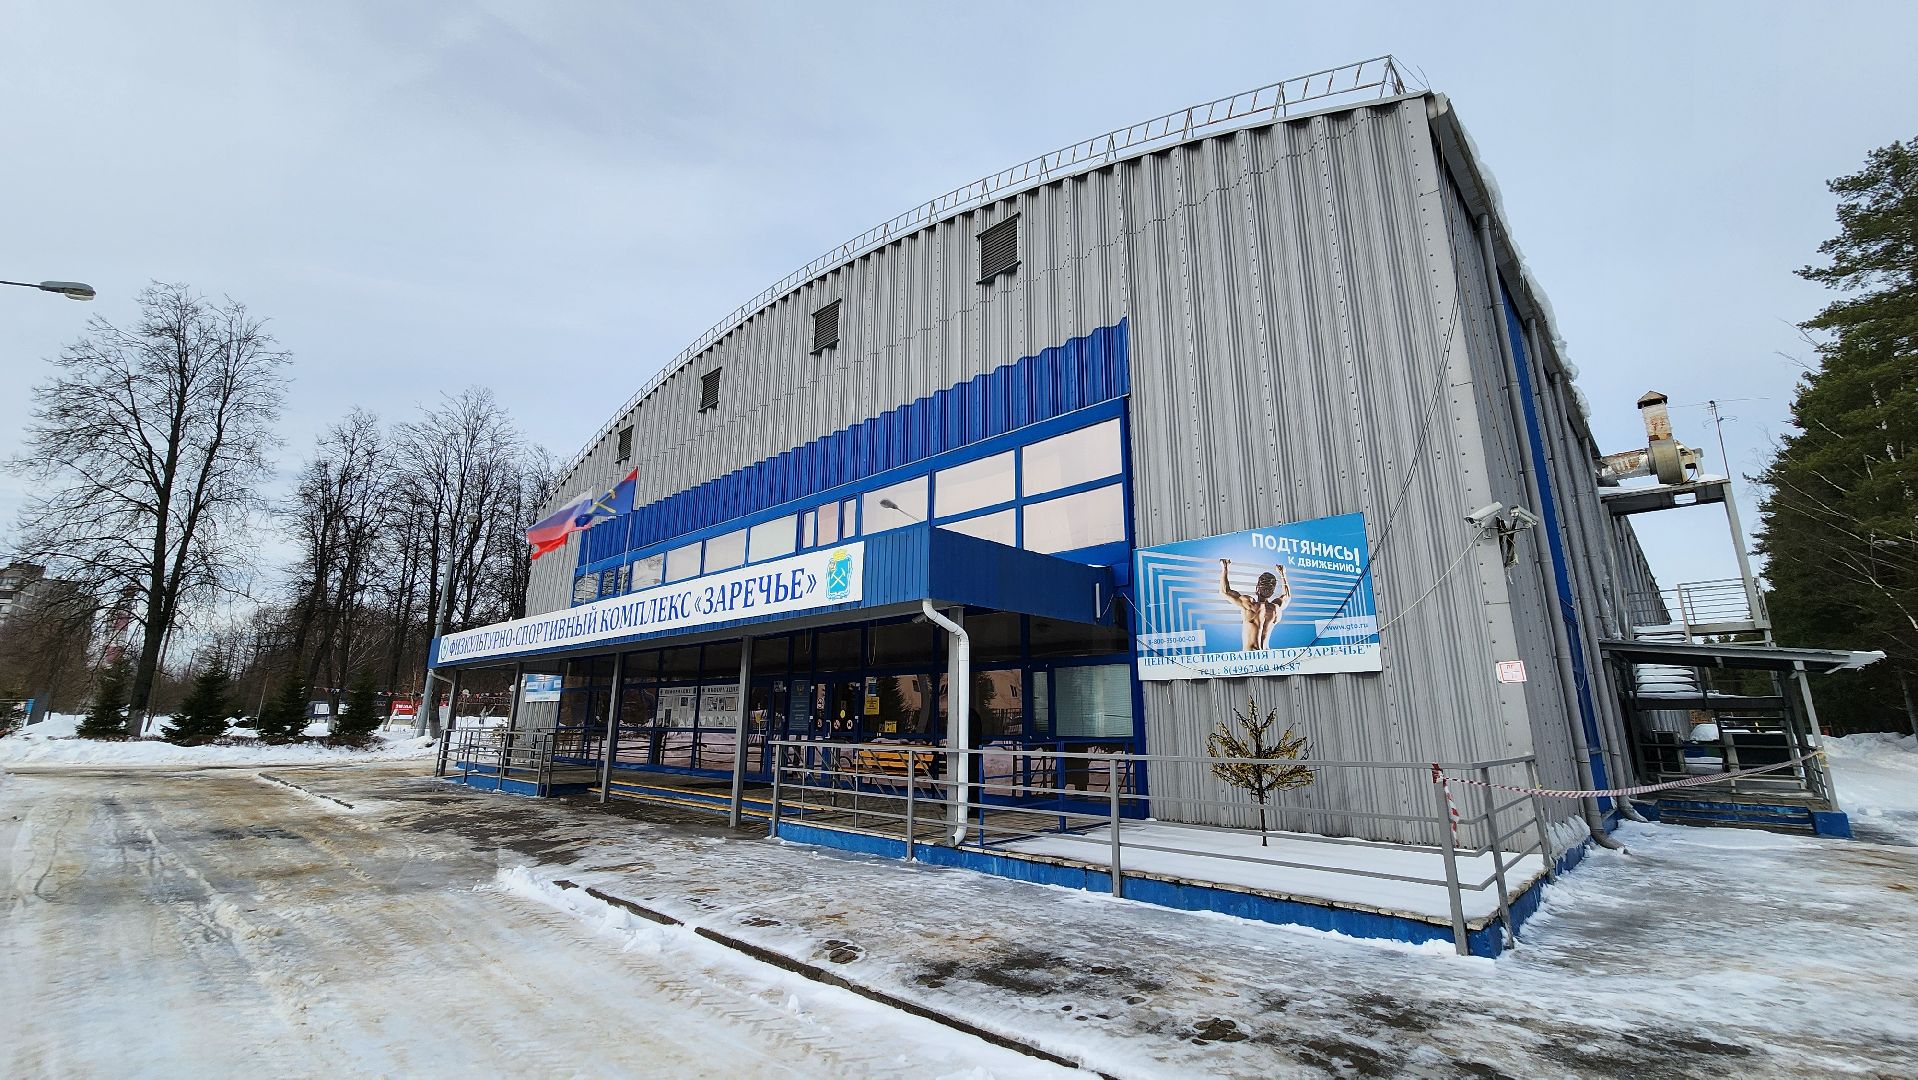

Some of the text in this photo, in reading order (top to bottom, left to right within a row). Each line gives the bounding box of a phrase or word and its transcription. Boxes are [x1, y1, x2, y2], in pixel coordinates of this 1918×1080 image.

[1287, 555, 1295, 566] К
[449, 567, 818, 657] ФИЗКУЛЬТУРНО-СПОРТИВНЫЙ КОМПЛЕКС «ЗАРЕЧЬЕ»
[1325, 622, 1369, 632] www.gto.ru
[1144, 655, 1177, 667] ЦЕНТР
[1180, 650, 1269, 664] ТЕСТИРОВАНИЯ
[1273, 648, 1296, 660] ГТО
